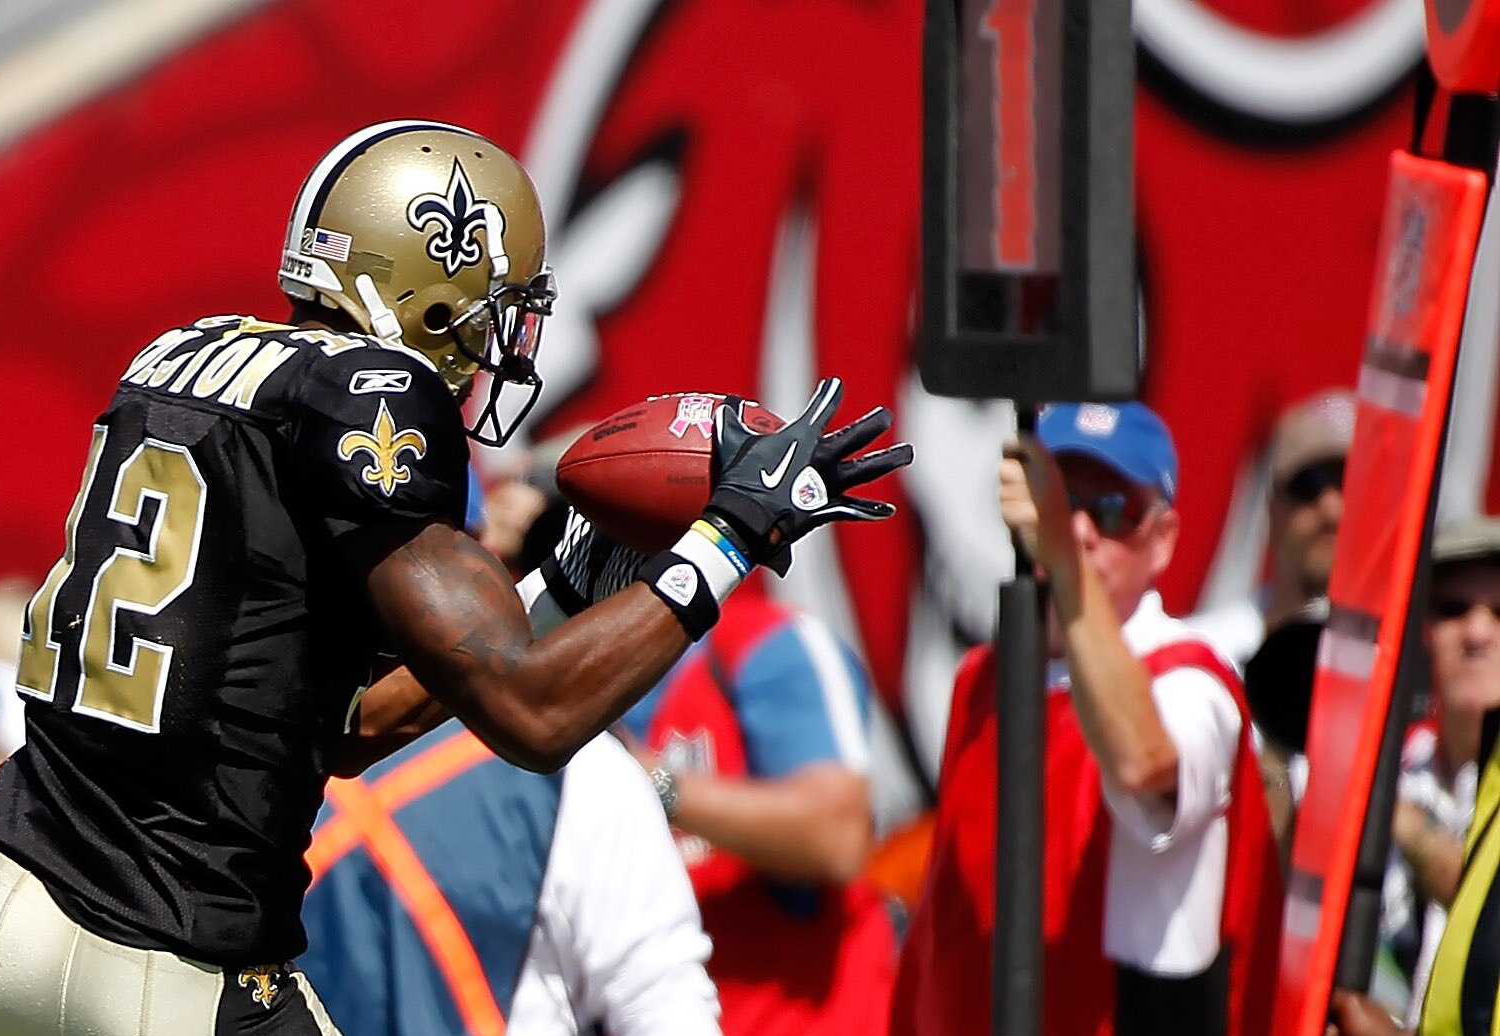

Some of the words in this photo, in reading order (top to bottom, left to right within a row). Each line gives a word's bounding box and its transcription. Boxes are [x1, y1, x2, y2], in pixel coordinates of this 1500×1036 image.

[283, 257, 313, 278] NTS
[979, 0, 1036, 269] 1
[16, 424, 207, 734] 12
